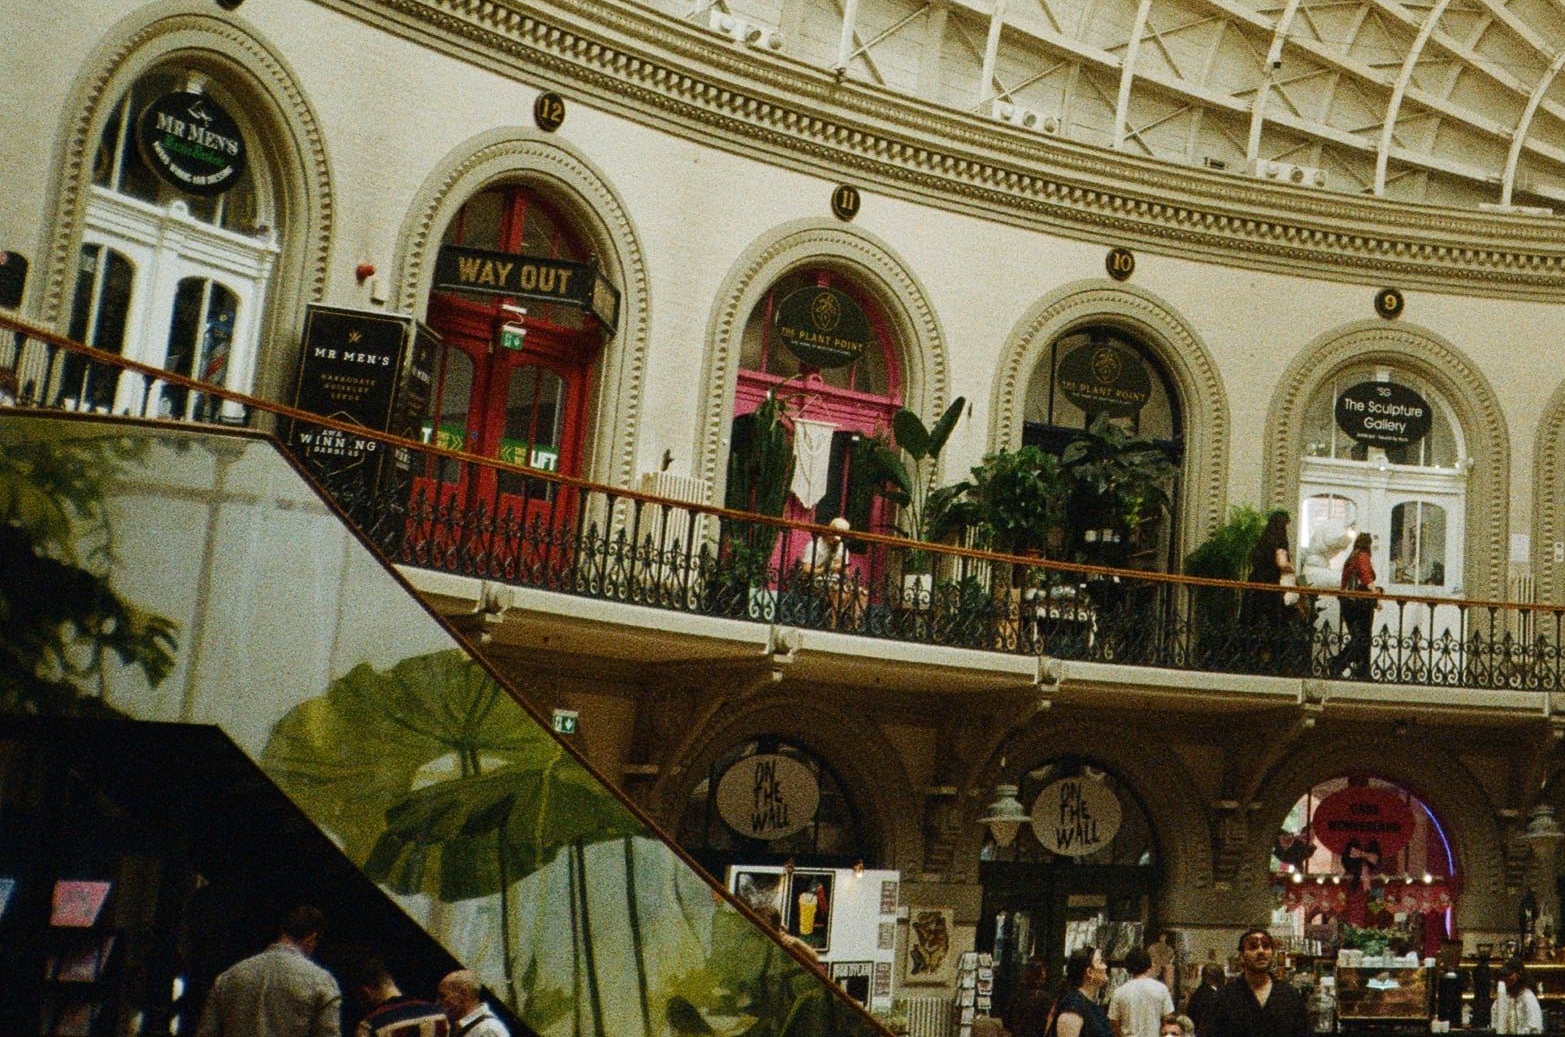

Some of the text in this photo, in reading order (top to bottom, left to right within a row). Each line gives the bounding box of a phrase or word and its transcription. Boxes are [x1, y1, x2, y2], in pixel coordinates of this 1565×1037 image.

[543, 98, 561, 122] 12
[156, 112, 185, 137] MR
[841, 191, 854, 209] 11
[1114, 253, 1132, 271] 10
[459, 257, 573, 294] WAY OUT
[1384, 294, 1398, 310] 9
[834, 337, 863, 352] POINT
[314, 347, 390, 366] MR MEN'S
[1344, 398, 1423, 418] The Sculpture
[1363, 416, 1406, 434] Gallery
[300, 433, 377, 452] WINNNG
[530, 449, 558, 472] LIFT
[755, 759, 776, 785] ON
[754, 780, 783, 809] THE
[1060, 782, 1082, 802] ON
[751, 804, 789, 833] WALL
[1060, 799, 1090, 824] THE
[1056, 820, 1100, 849] WALL
